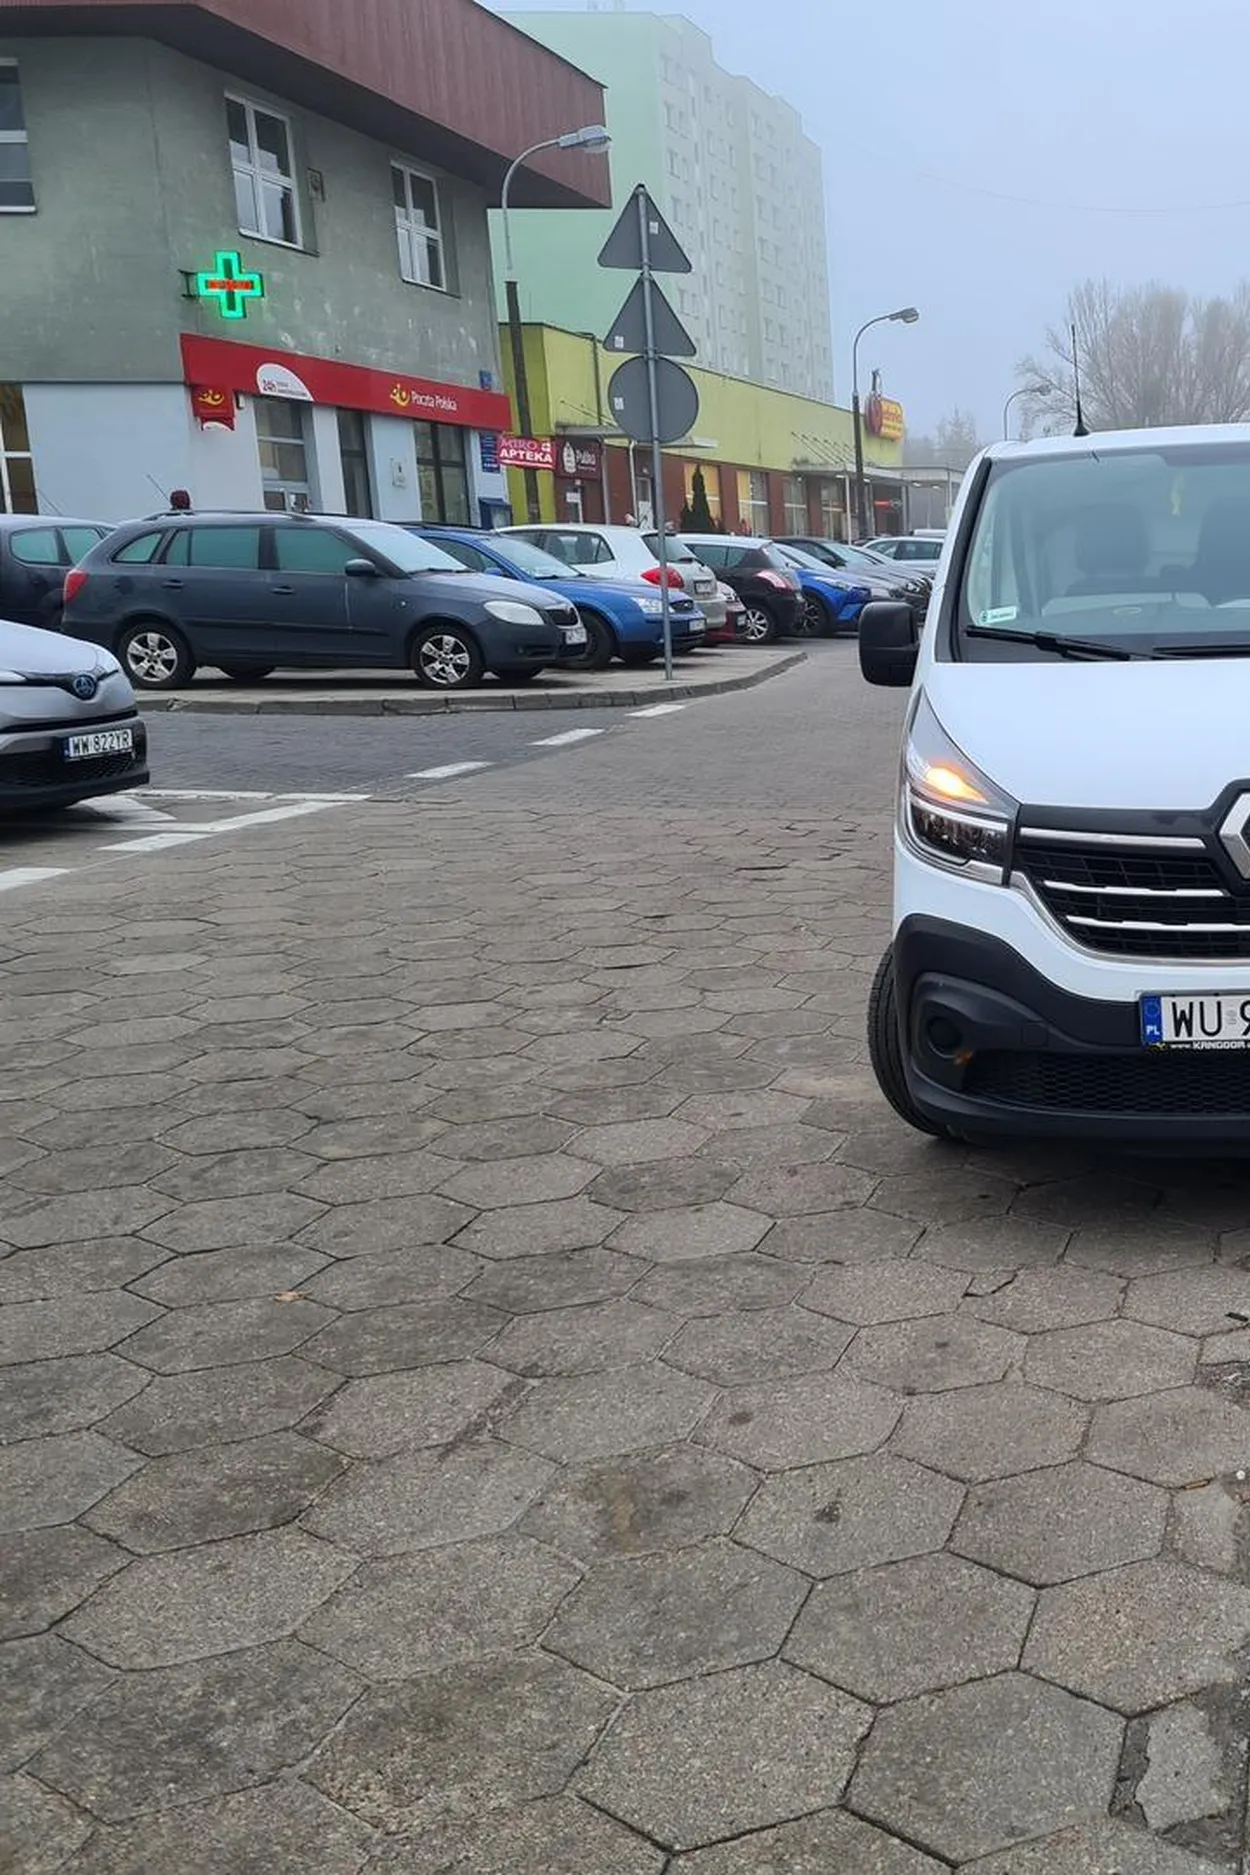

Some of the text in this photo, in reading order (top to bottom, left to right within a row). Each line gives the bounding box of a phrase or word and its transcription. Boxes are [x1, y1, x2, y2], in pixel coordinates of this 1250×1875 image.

[411, 390, 457, 411] Poczta Polska
[500, 438, 537, 451] MIRO
[499, 448, 553, 463] APTEKA
[1171, 1000, 1222, 1038] WU
[1146, 1026, 1160, 1036] PL
